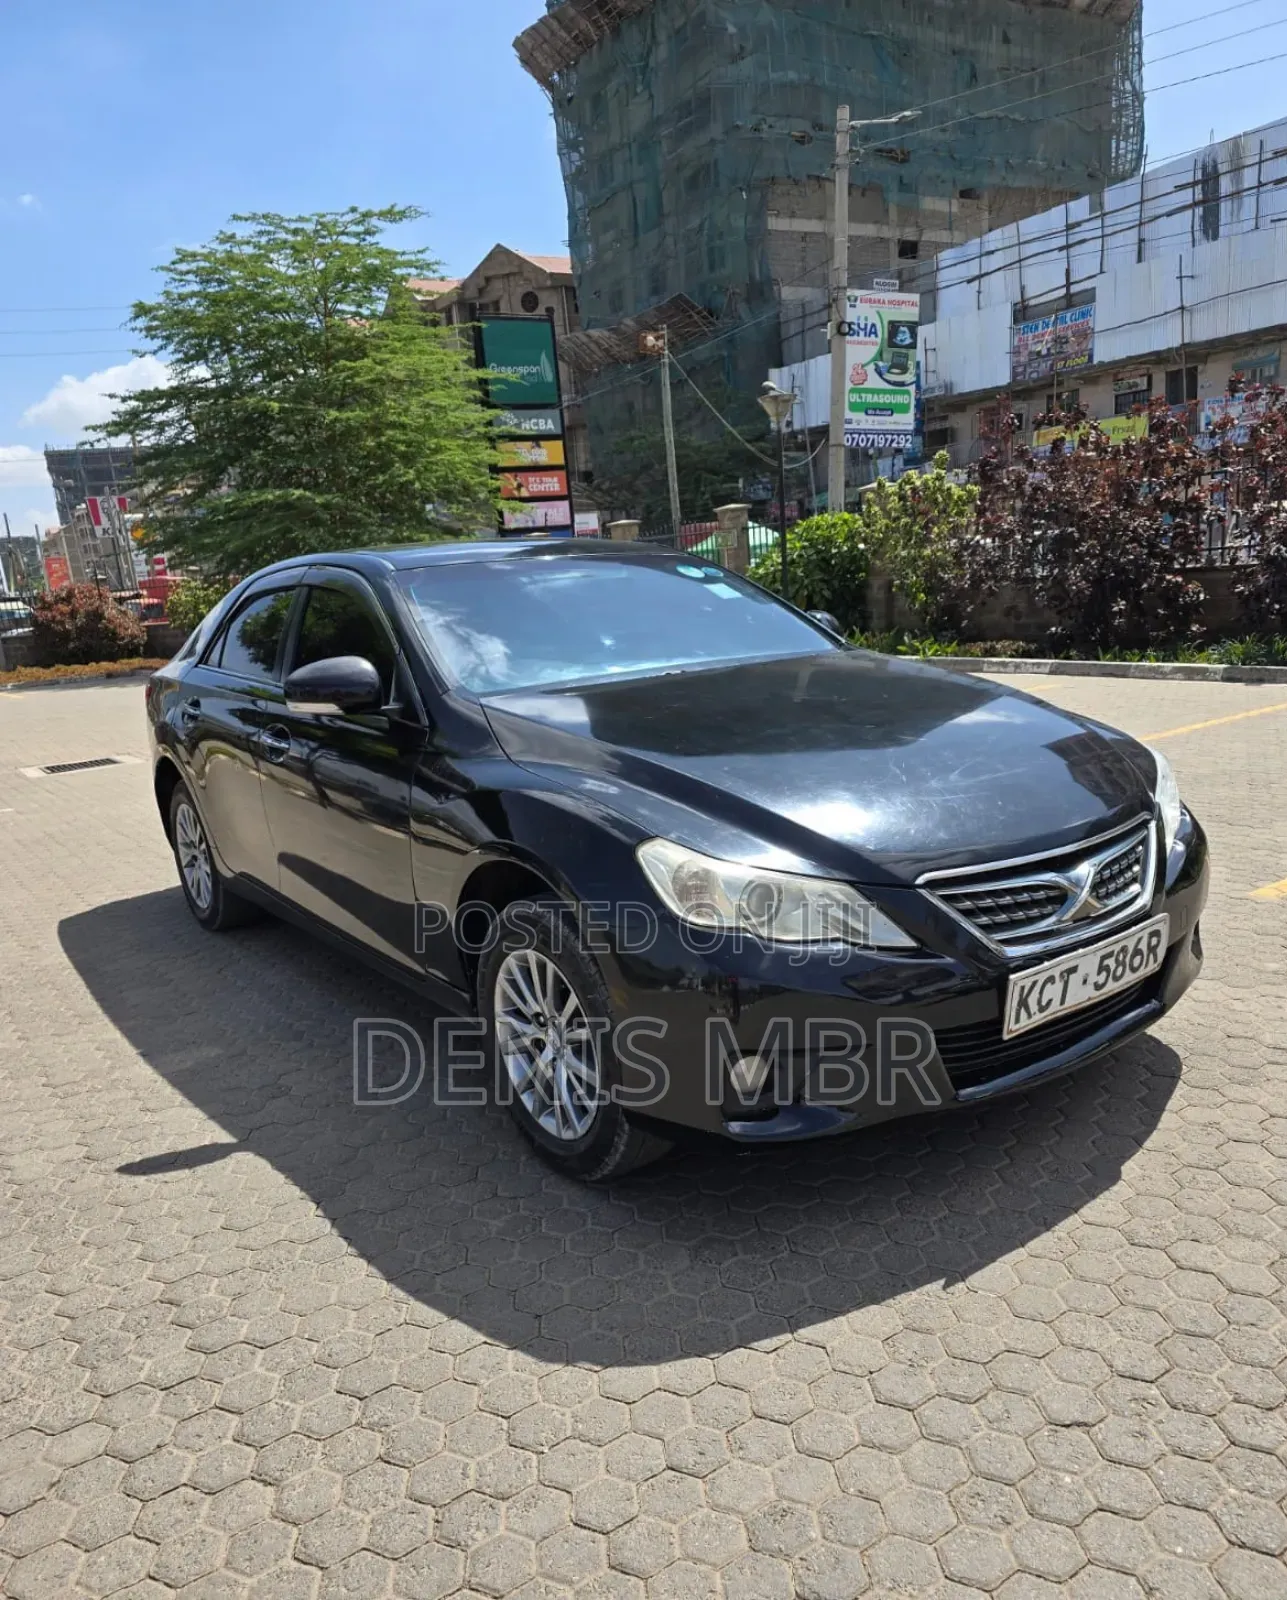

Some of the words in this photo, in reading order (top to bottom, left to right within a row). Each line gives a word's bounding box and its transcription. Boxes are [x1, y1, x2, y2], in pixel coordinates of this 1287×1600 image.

[888, 299, 918, 308] HOSPITAL
[1070, 306, 1093, 321] CLINIC
[847, 320, 878, 337] SHA
[489, 363, 541, 376] Greenspan
[849, 393, 910, 404] ULTRASOUND
[521, 418, 555, 431] NCBA
[844, 434, 912, 448] 0707197292
[1014, 963, 1079, 1025] KCT
[1093, 928, 1162, 992] 586R
